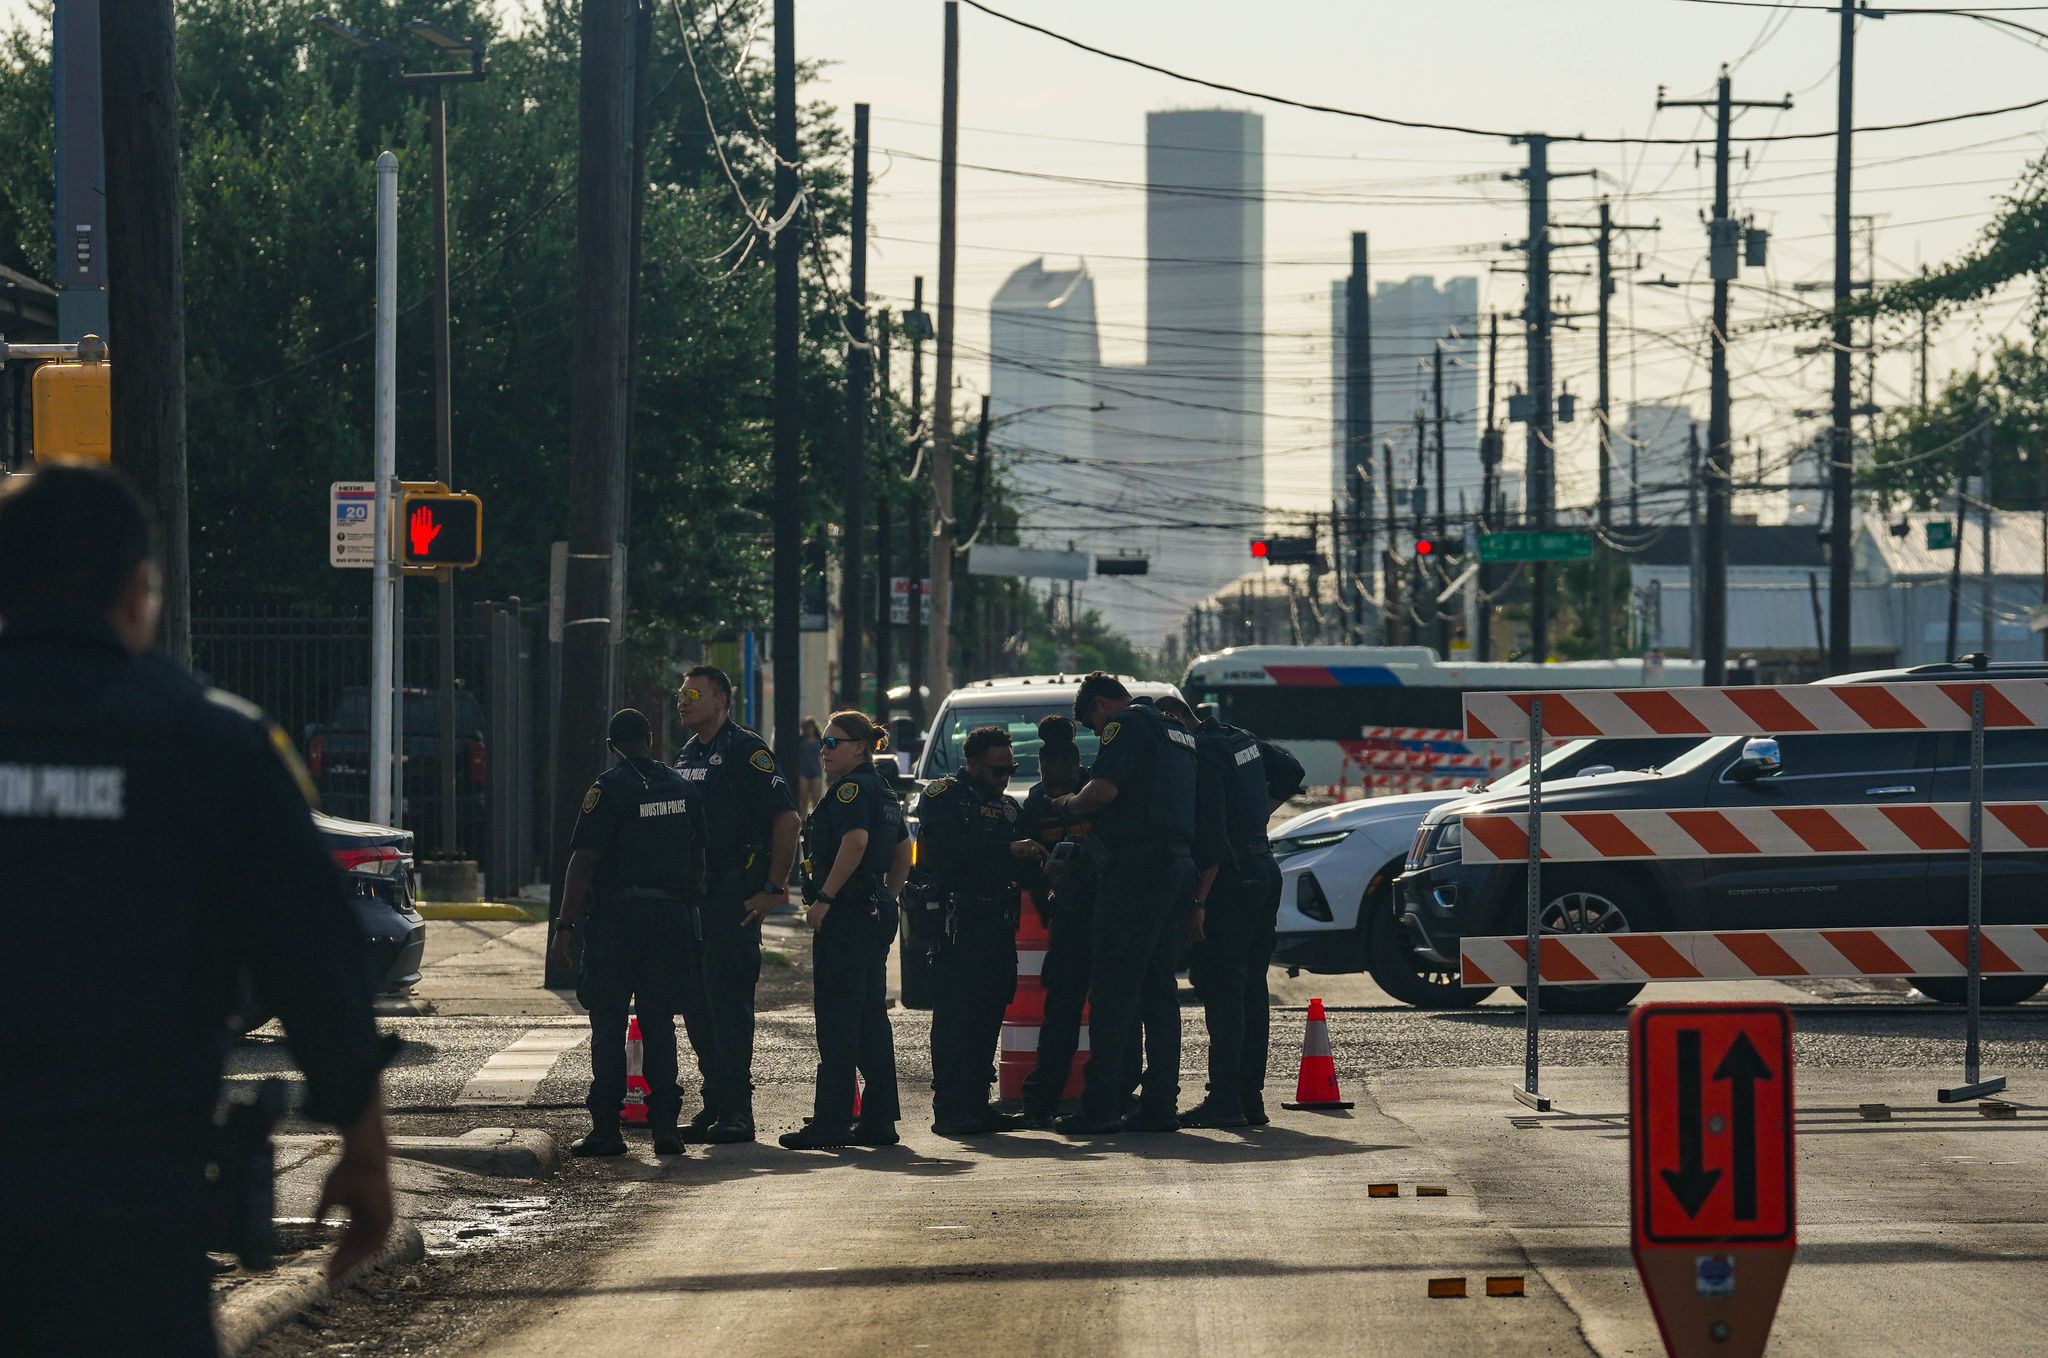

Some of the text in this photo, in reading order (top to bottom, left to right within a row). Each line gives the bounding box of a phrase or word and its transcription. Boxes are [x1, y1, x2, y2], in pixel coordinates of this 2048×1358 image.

[346, 507, 365, 518] 20
[689, 768, 708, 781] POLICE
[42, 765, 123, 817] POLICE
[640, 800, 686, 817] HOUSTON POLICE
